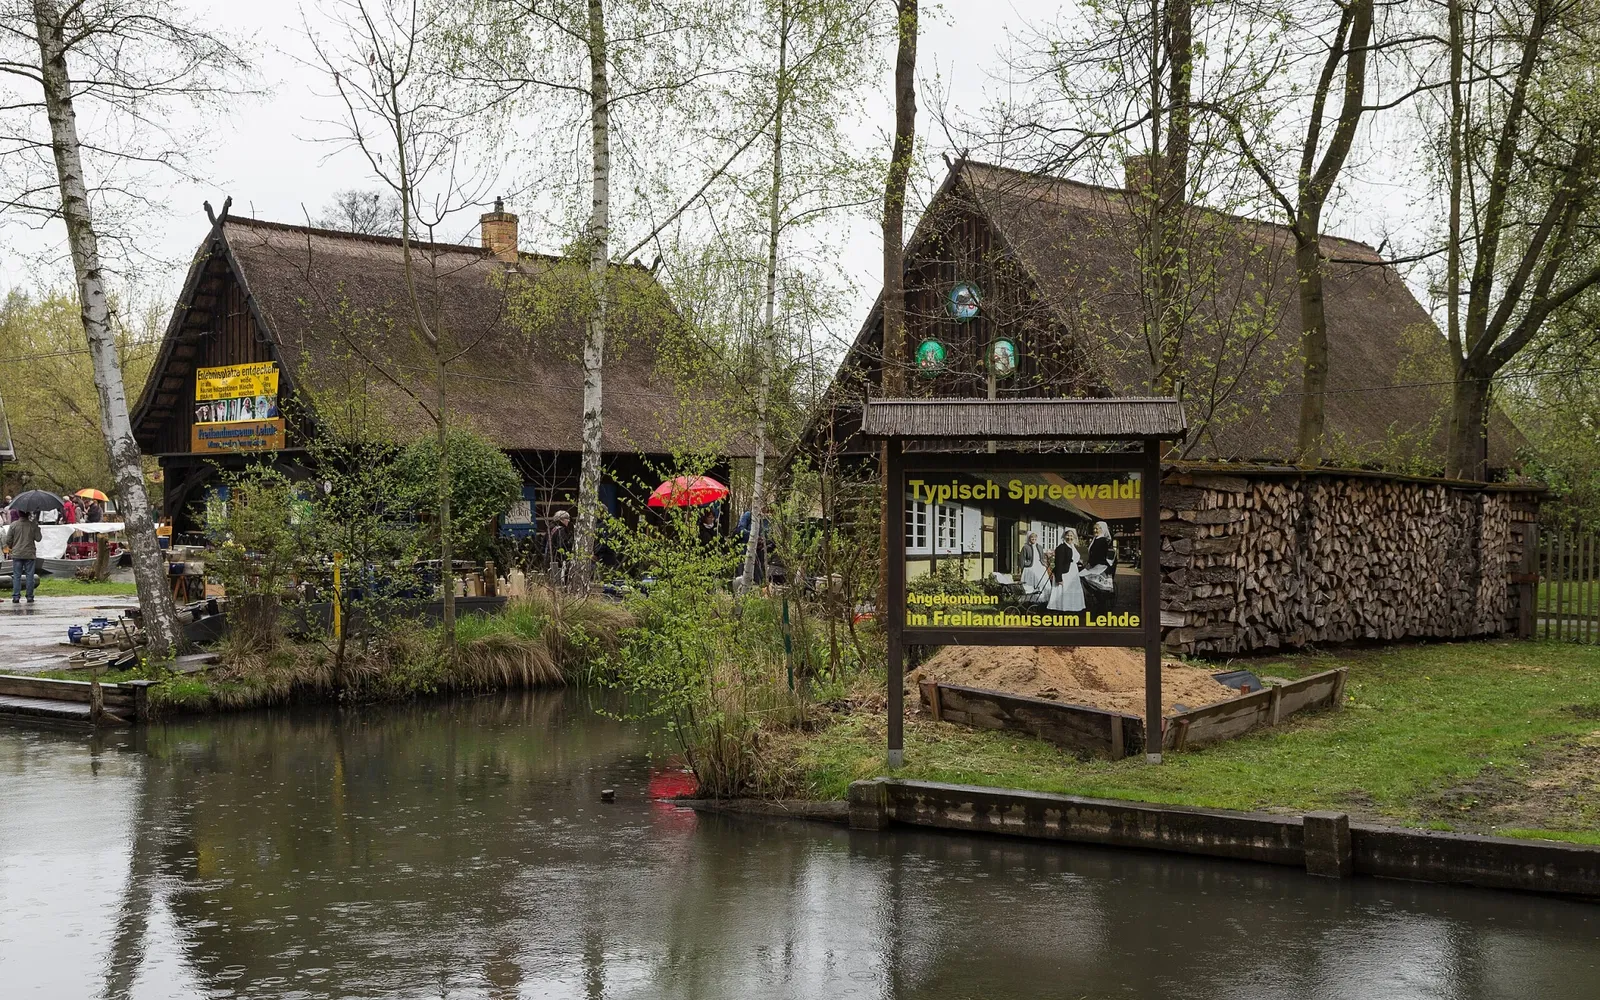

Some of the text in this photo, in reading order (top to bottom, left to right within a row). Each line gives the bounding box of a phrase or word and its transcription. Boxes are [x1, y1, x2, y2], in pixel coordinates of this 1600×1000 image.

[908, 479, 1141, 505] Typisch Spreewald!
[906, 592, 999, 607] Angekommen
[906, 611, 1141, 627] im Freilandmuseum Lehde
